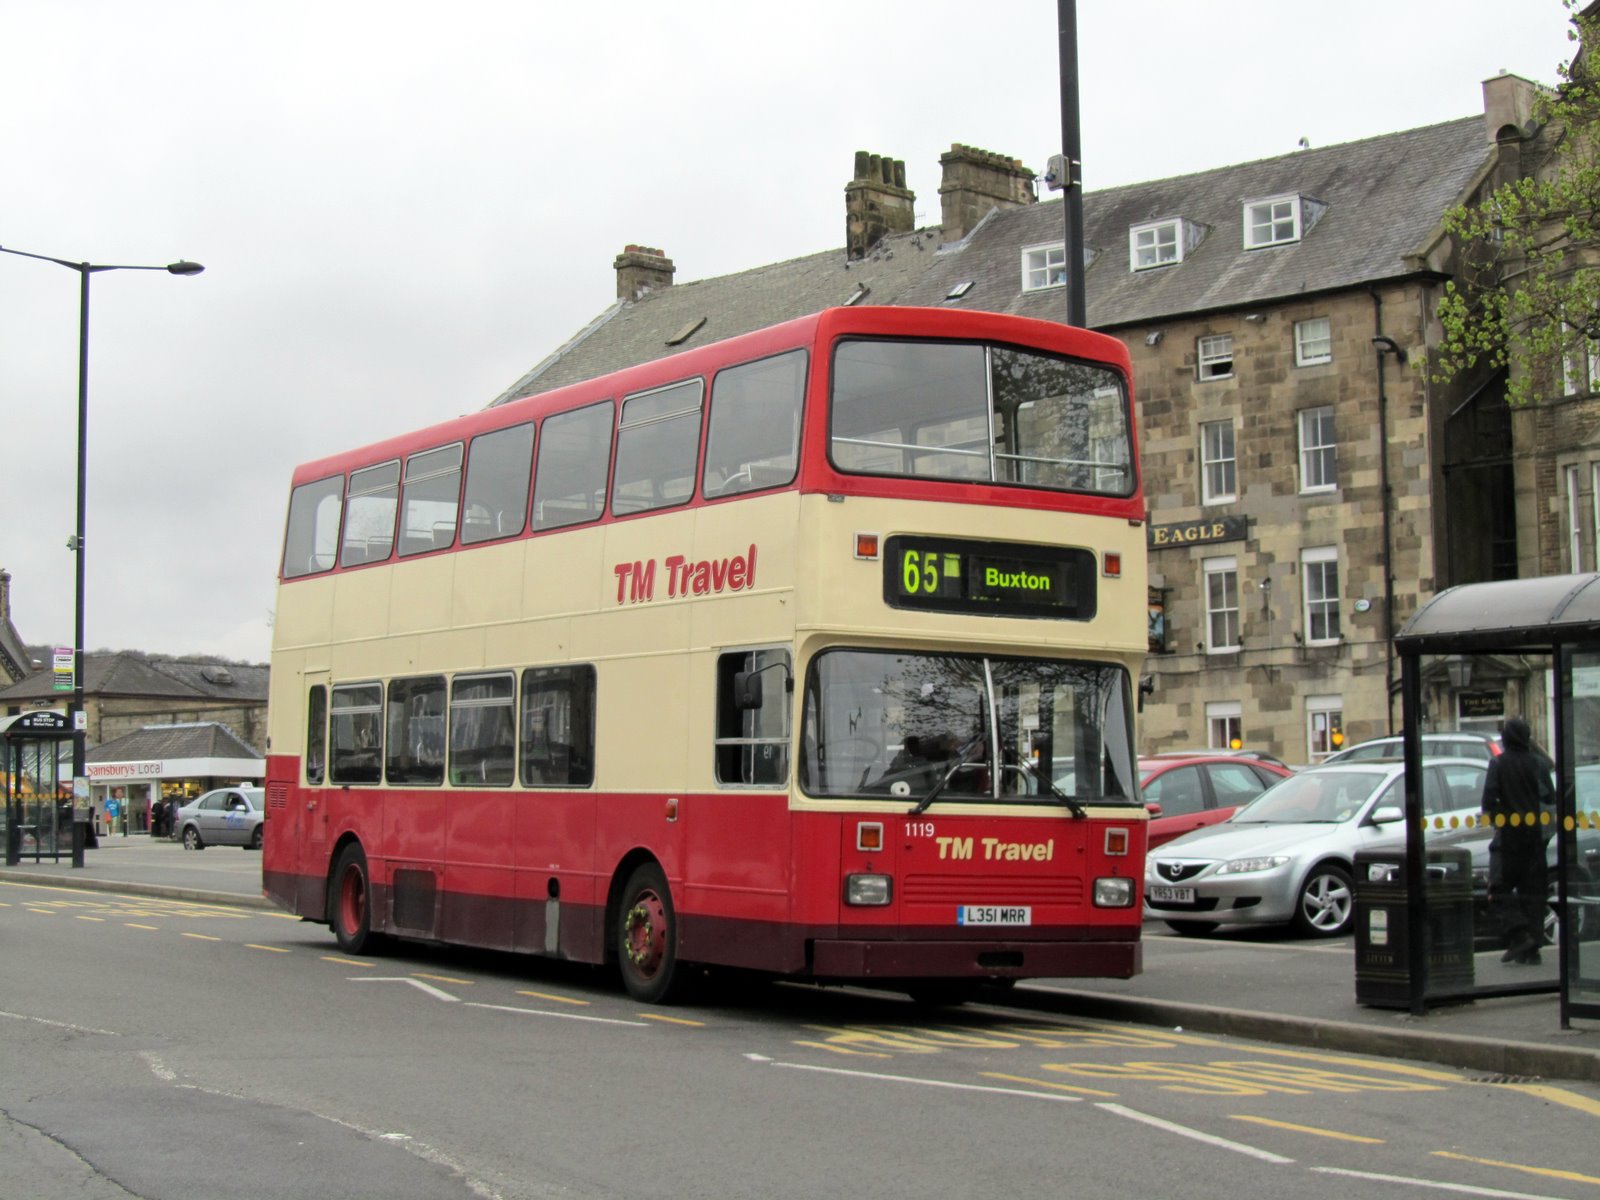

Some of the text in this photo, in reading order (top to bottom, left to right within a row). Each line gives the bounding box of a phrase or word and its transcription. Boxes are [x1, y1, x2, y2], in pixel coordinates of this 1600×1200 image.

[1153, 523, 1226, 545] EAGLE
[614, 543, 758, 605] TM Travel
[903, 550, 938, 594] 65
[985, 568, 1050, 591] Buxton
[88, 761, 163, 777] Sainsbury's Local
[904, 822, 935, 837] 1119
[936, 837, 1054, 861] TM Travel
[967, 907, 1026, 923] L351 MRR
[1042, 1060, 1448, 1096] BUS
